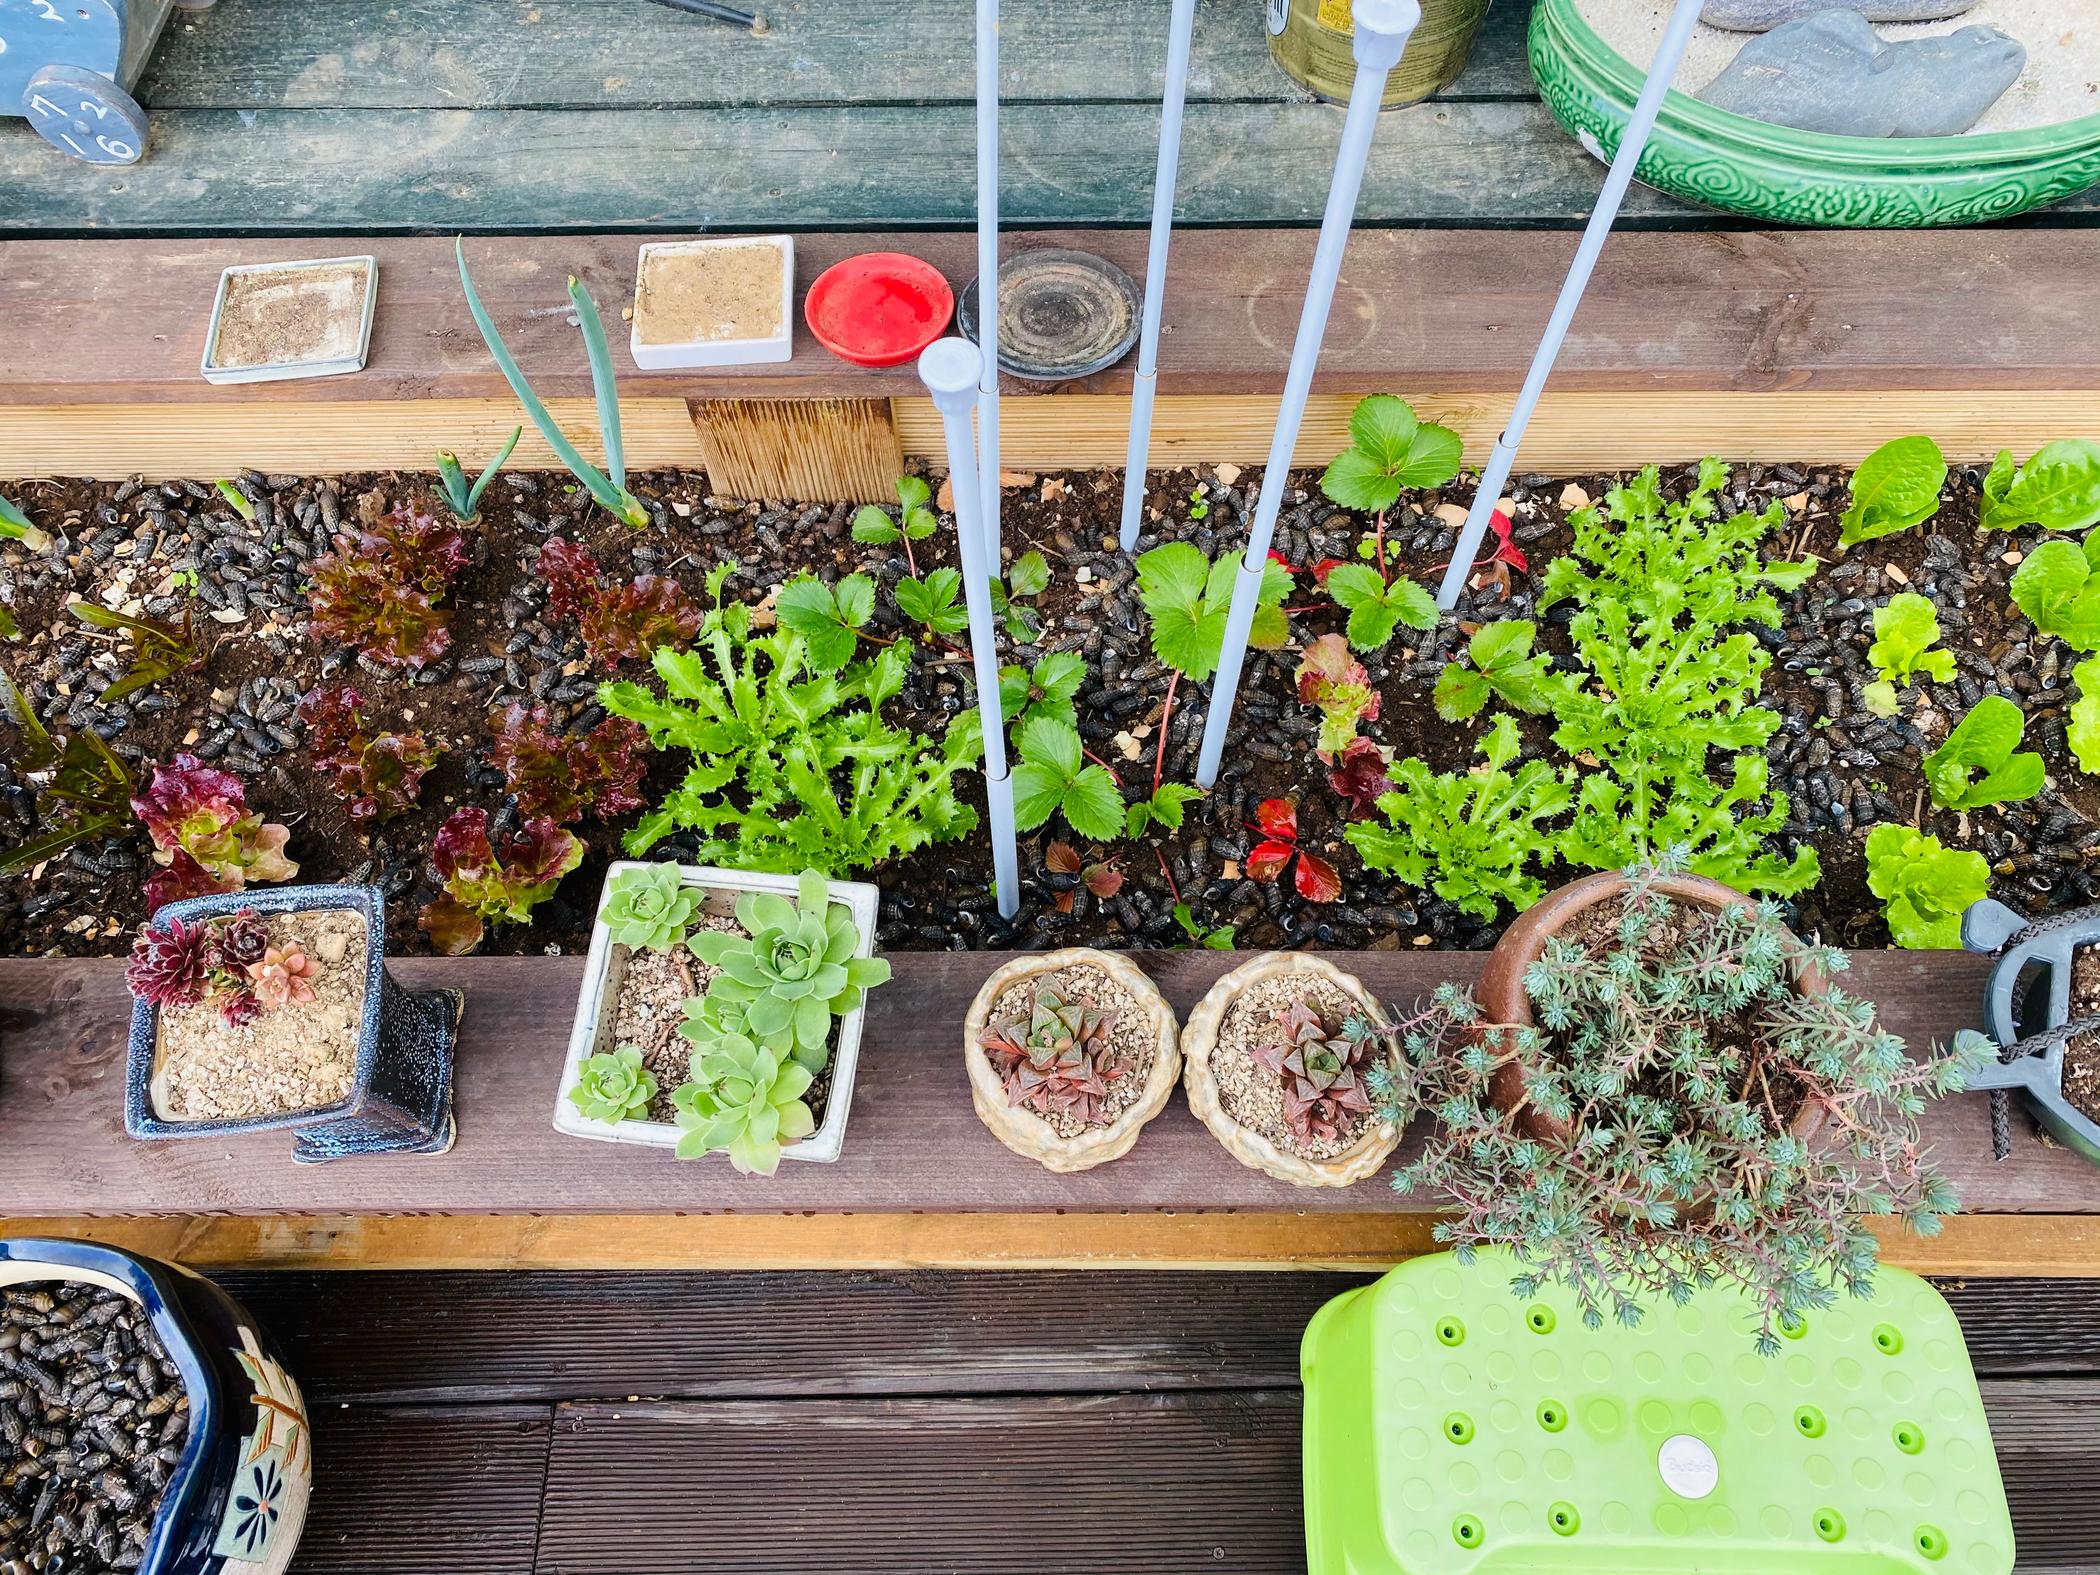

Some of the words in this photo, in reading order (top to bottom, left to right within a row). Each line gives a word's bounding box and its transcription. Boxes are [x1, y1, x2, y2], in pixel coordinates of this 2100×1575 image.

[80, 101, 108, 120] 2
[60, 133, 86, 155] 1
[95, 135, 135, 159] 6
